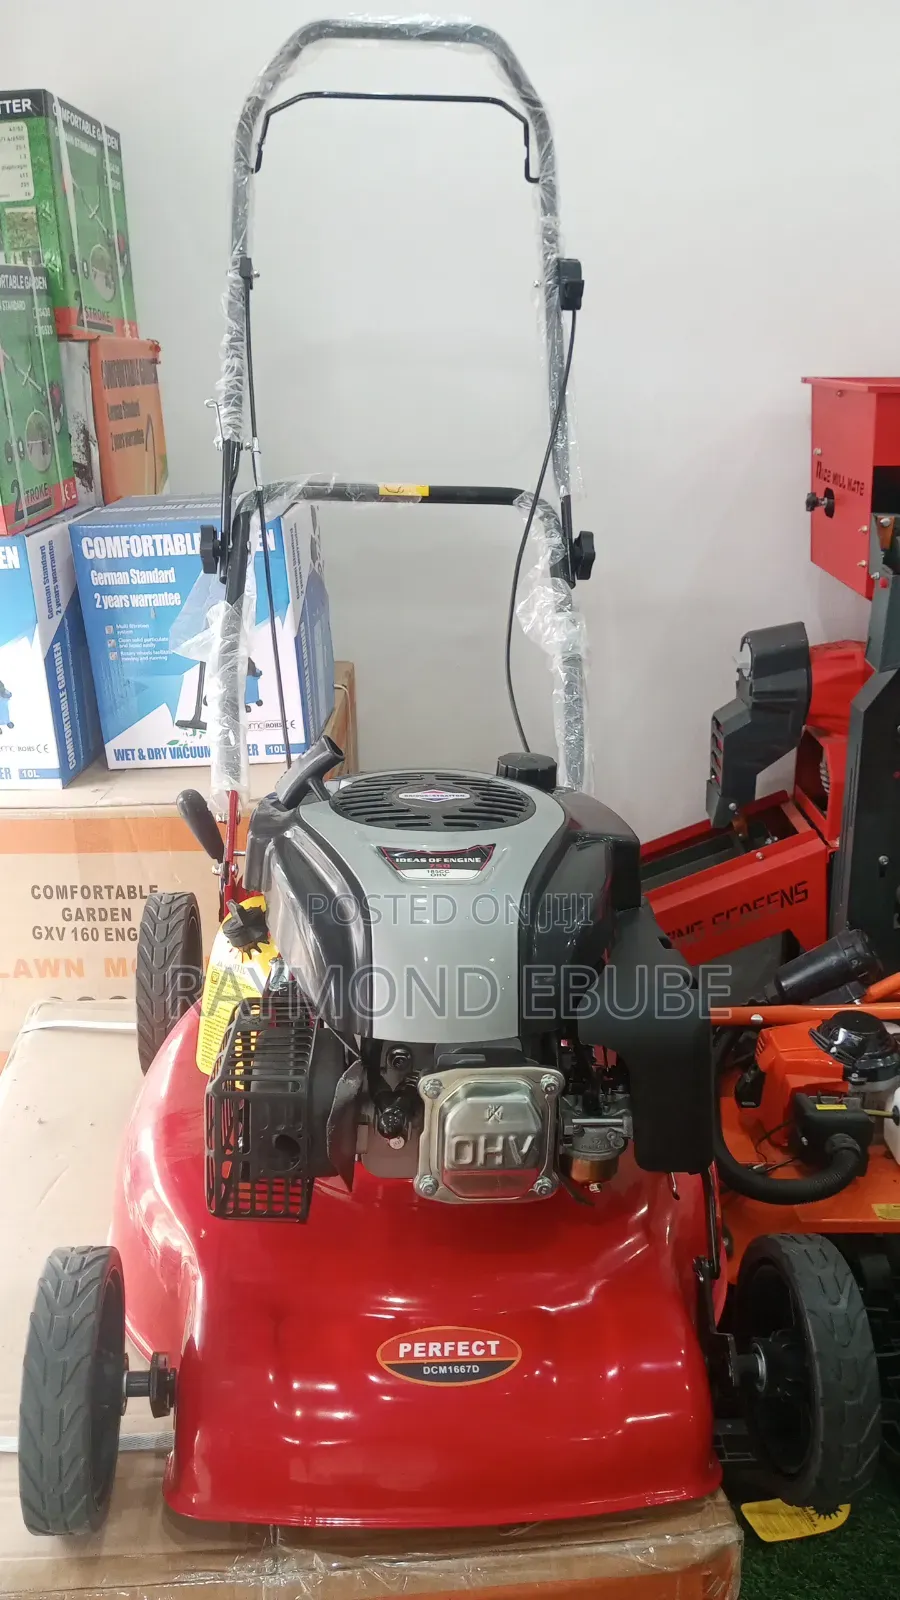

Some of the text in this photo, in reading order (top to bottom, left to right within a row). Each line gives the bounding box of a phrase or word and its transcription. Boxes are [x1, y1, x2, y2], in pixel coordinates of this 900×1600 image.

[39, 545, 50, 586] Standard
[90, 566, 176, 586] German Standard
[93, 591, 182, 610] 2 years warrantee
[52, 641, 77, 770] COMFORTABLE GARDEN
[114, 748, 136, 762] WET
[137, 748, 147, 760] &
[147, 747, 167, 760] DRY
[22, 769, 40, 778] 10L
[61, 907, 132, 922] GARDEN
[32, 926, 66, 941] GXV
[71, 927, 99, 941] 160
[451, 1135, 536, 1166] OHV
[398, 1340, 501, 1358] PERFECT
[422, 1364, 480, 1376] DCM1667D
